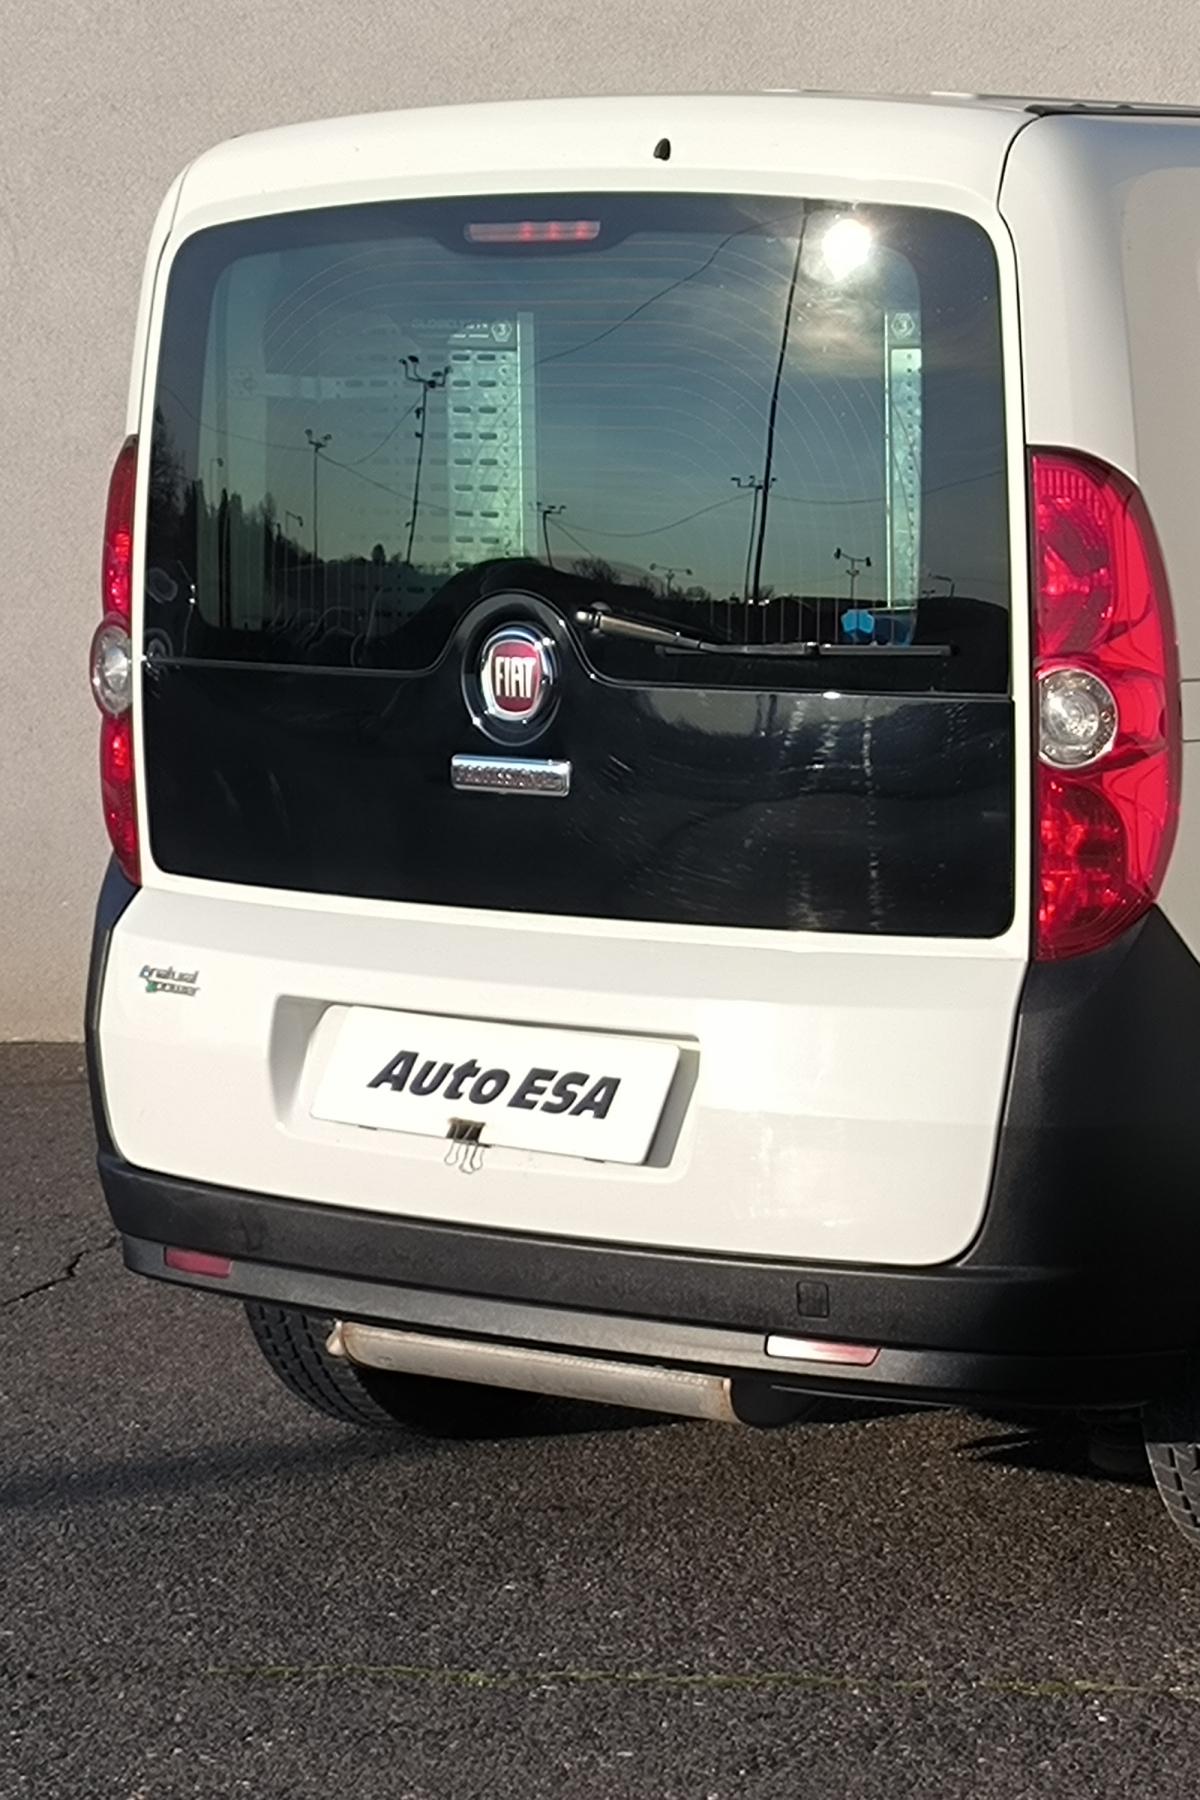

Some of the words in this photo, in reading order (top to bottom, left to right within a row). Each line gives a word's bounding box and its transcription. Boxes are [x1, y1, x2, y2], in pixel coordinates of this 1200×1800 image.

[495, 656, 537, 699] FIAT
[366, 1049, 511, 1105] Auto
[506, 1067, 622, 1120] ESA
